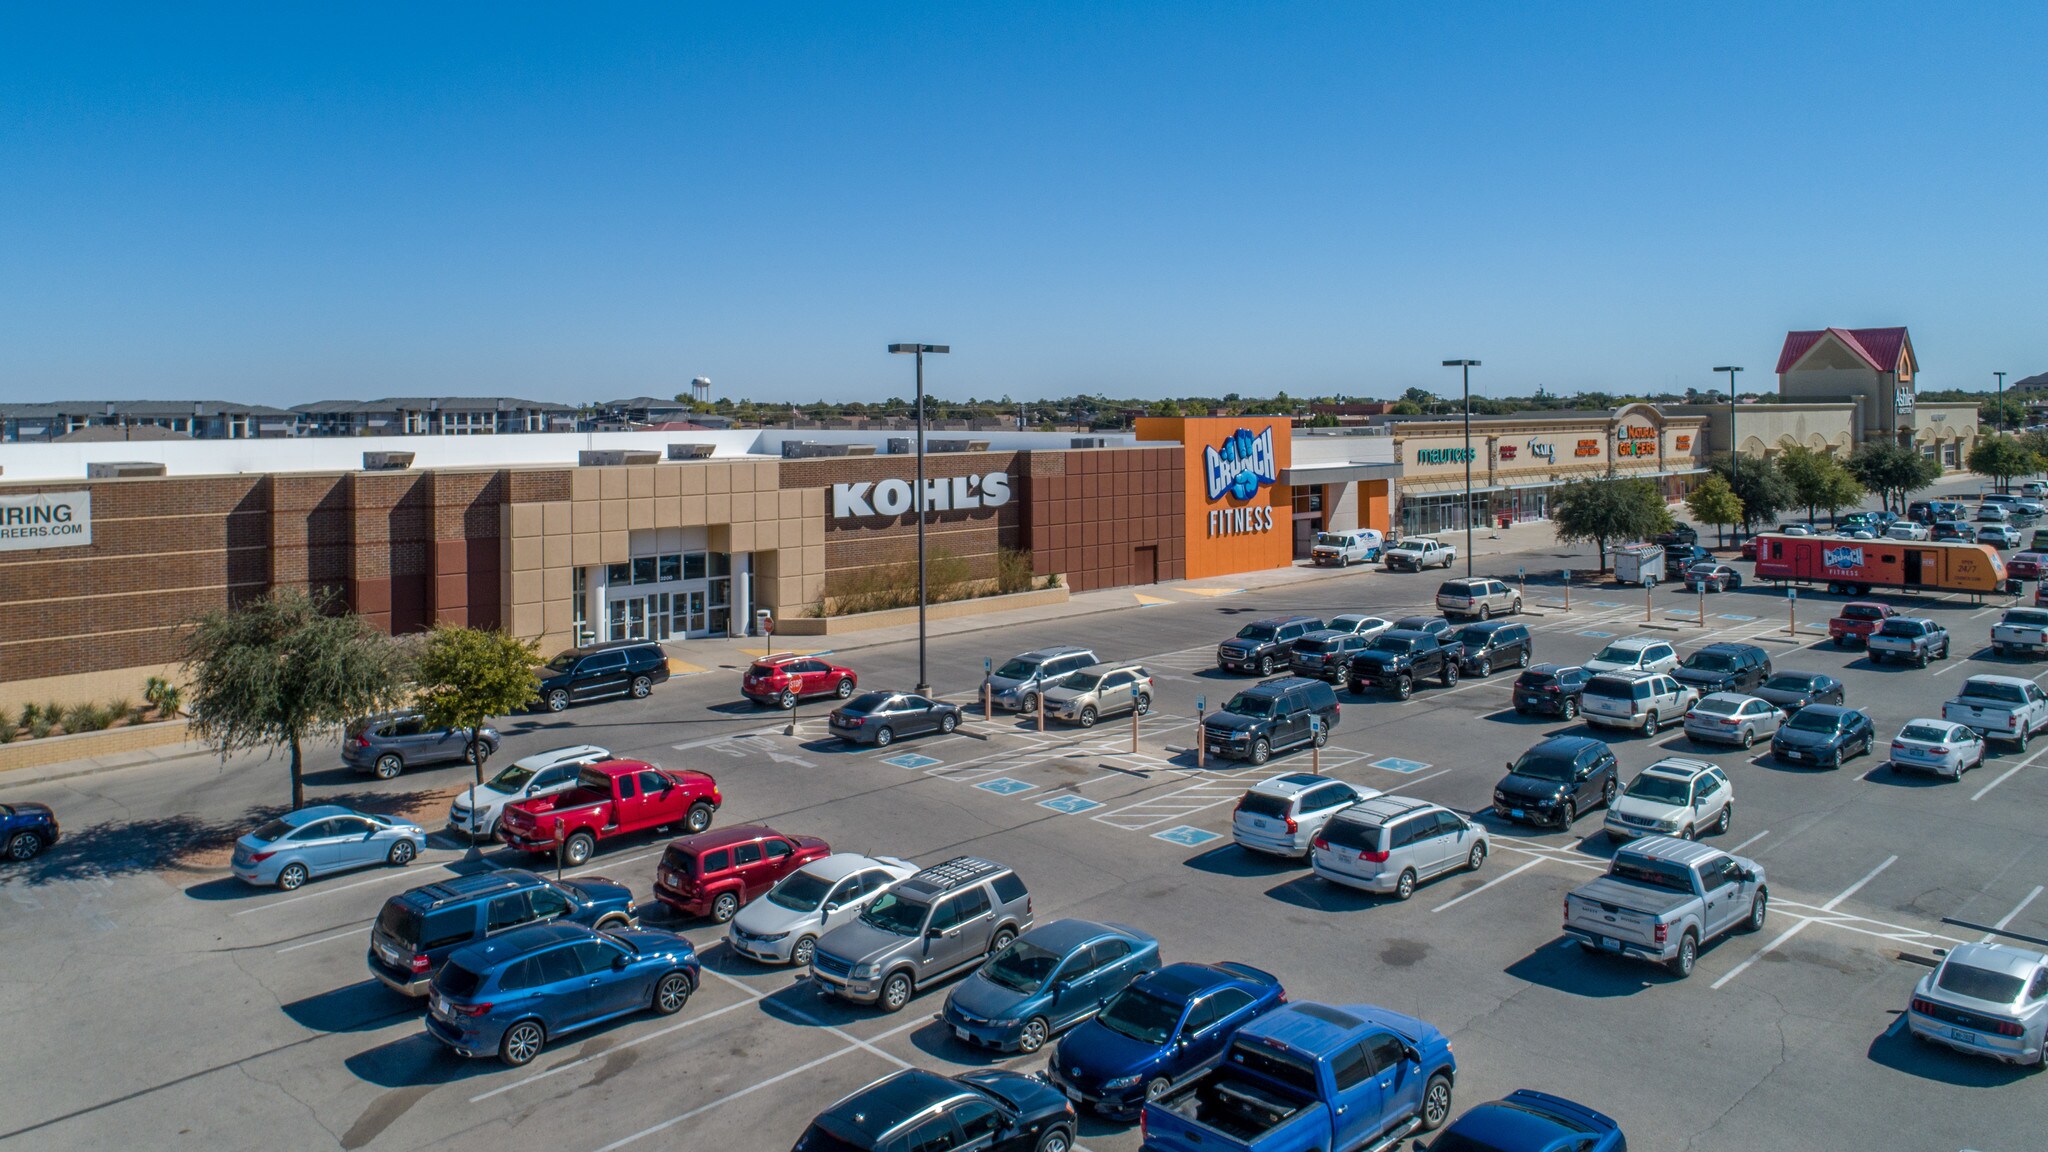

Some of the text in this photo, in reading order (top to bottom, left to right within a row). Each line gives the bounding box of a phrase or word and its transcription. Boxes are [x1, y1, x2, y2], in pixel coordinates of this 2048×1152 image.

[1895, 387, 1915, 410] Ashley
[1418, 447, 1476, 463] maurices
[1532, 443, 1555, 457] NAILS
[1207, 427, 1276, 499] CRUNCH
[833, 472, 1011, 518] KOHL'S
[1209, 505, 1273, 536] FITNESS
[1823, 547, 1864, 566] CRUNCH
[789, 679, 802, 688] STOP
